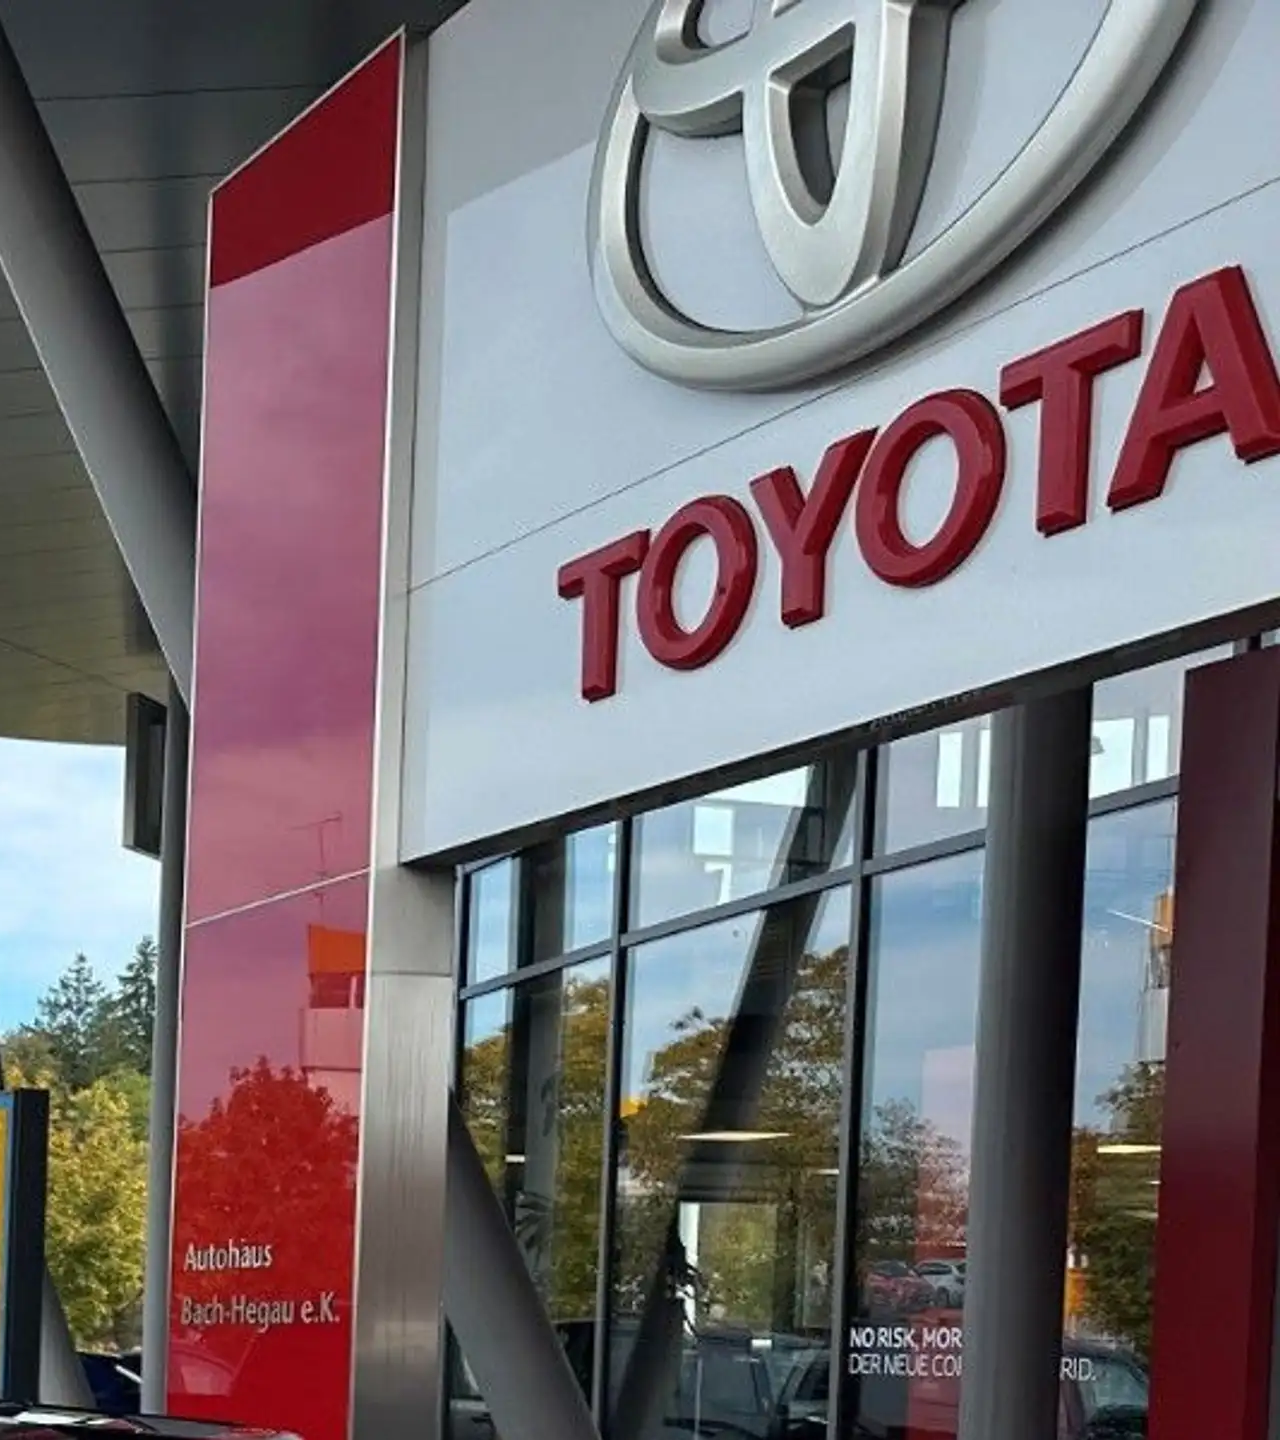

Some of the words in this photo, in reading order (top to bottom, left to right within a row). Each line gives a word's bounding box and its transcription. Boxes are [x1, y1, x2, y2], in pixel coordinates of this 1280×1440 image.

[558, 265, 1280, 703] TOYOTA
[184, 1239, 273, 1271] Autohaus
[181, 1294, 295, 1333] Bach-Hegau
[301, 1291, 340, 1324] e.K.
[849, 1327, 874, 1348] NO
[877, 1327, 919, 1351] RISK,
[922, 1327, 963, 1349] MOR
[848, 1353, 881, 1375] DER
[884, 1354, 929, 1377] NEUE
